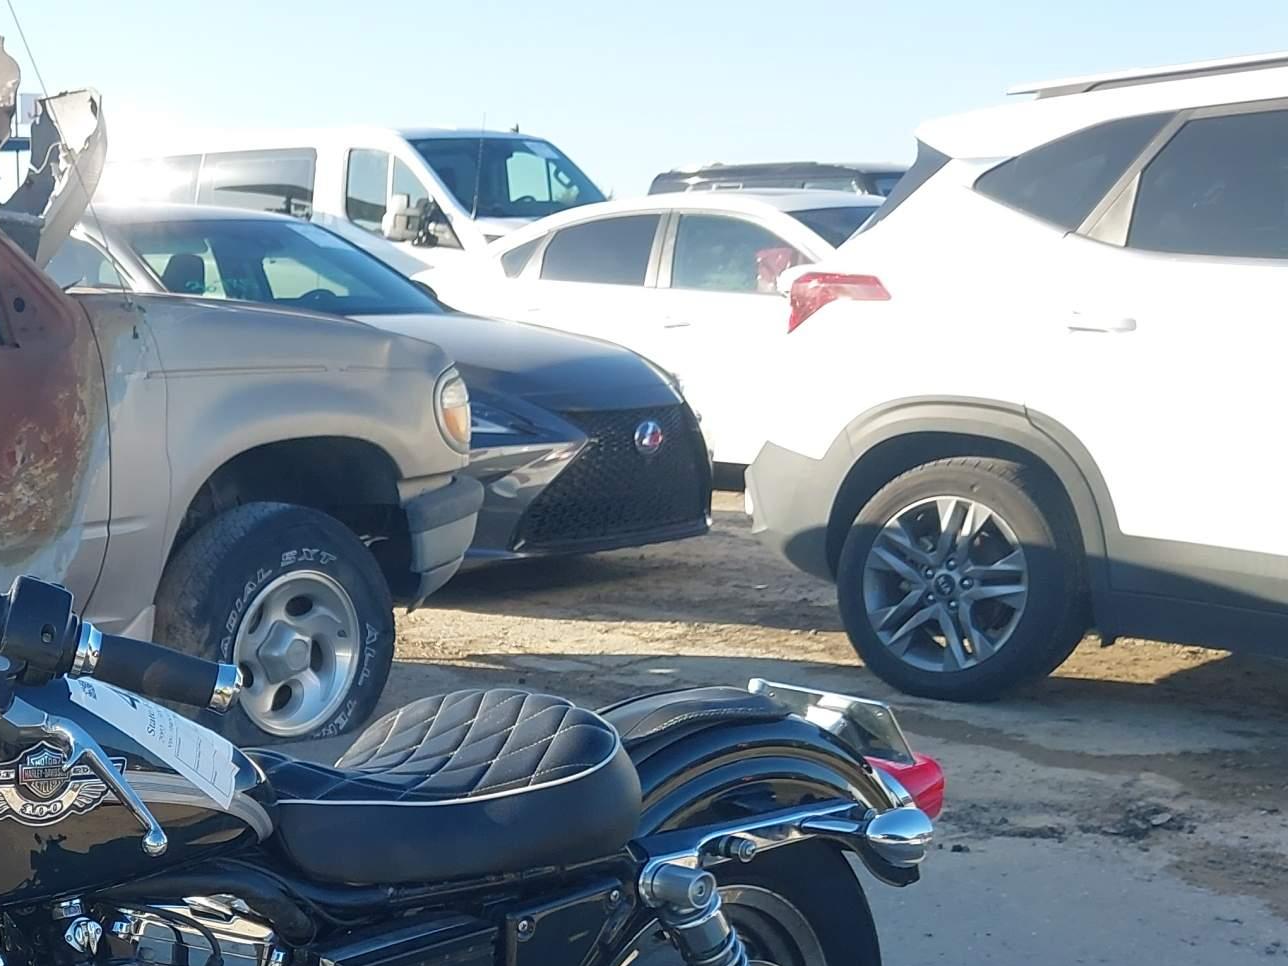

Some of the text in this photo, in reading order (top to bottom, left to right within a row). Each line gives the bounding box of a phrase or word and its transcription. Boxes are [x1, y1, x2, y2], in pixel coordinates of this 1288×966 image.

[217, 547, 337, 665] ADIAL EXT
[357, 622, 379, 687] ALL
[20, 801, 63, 818] 100
